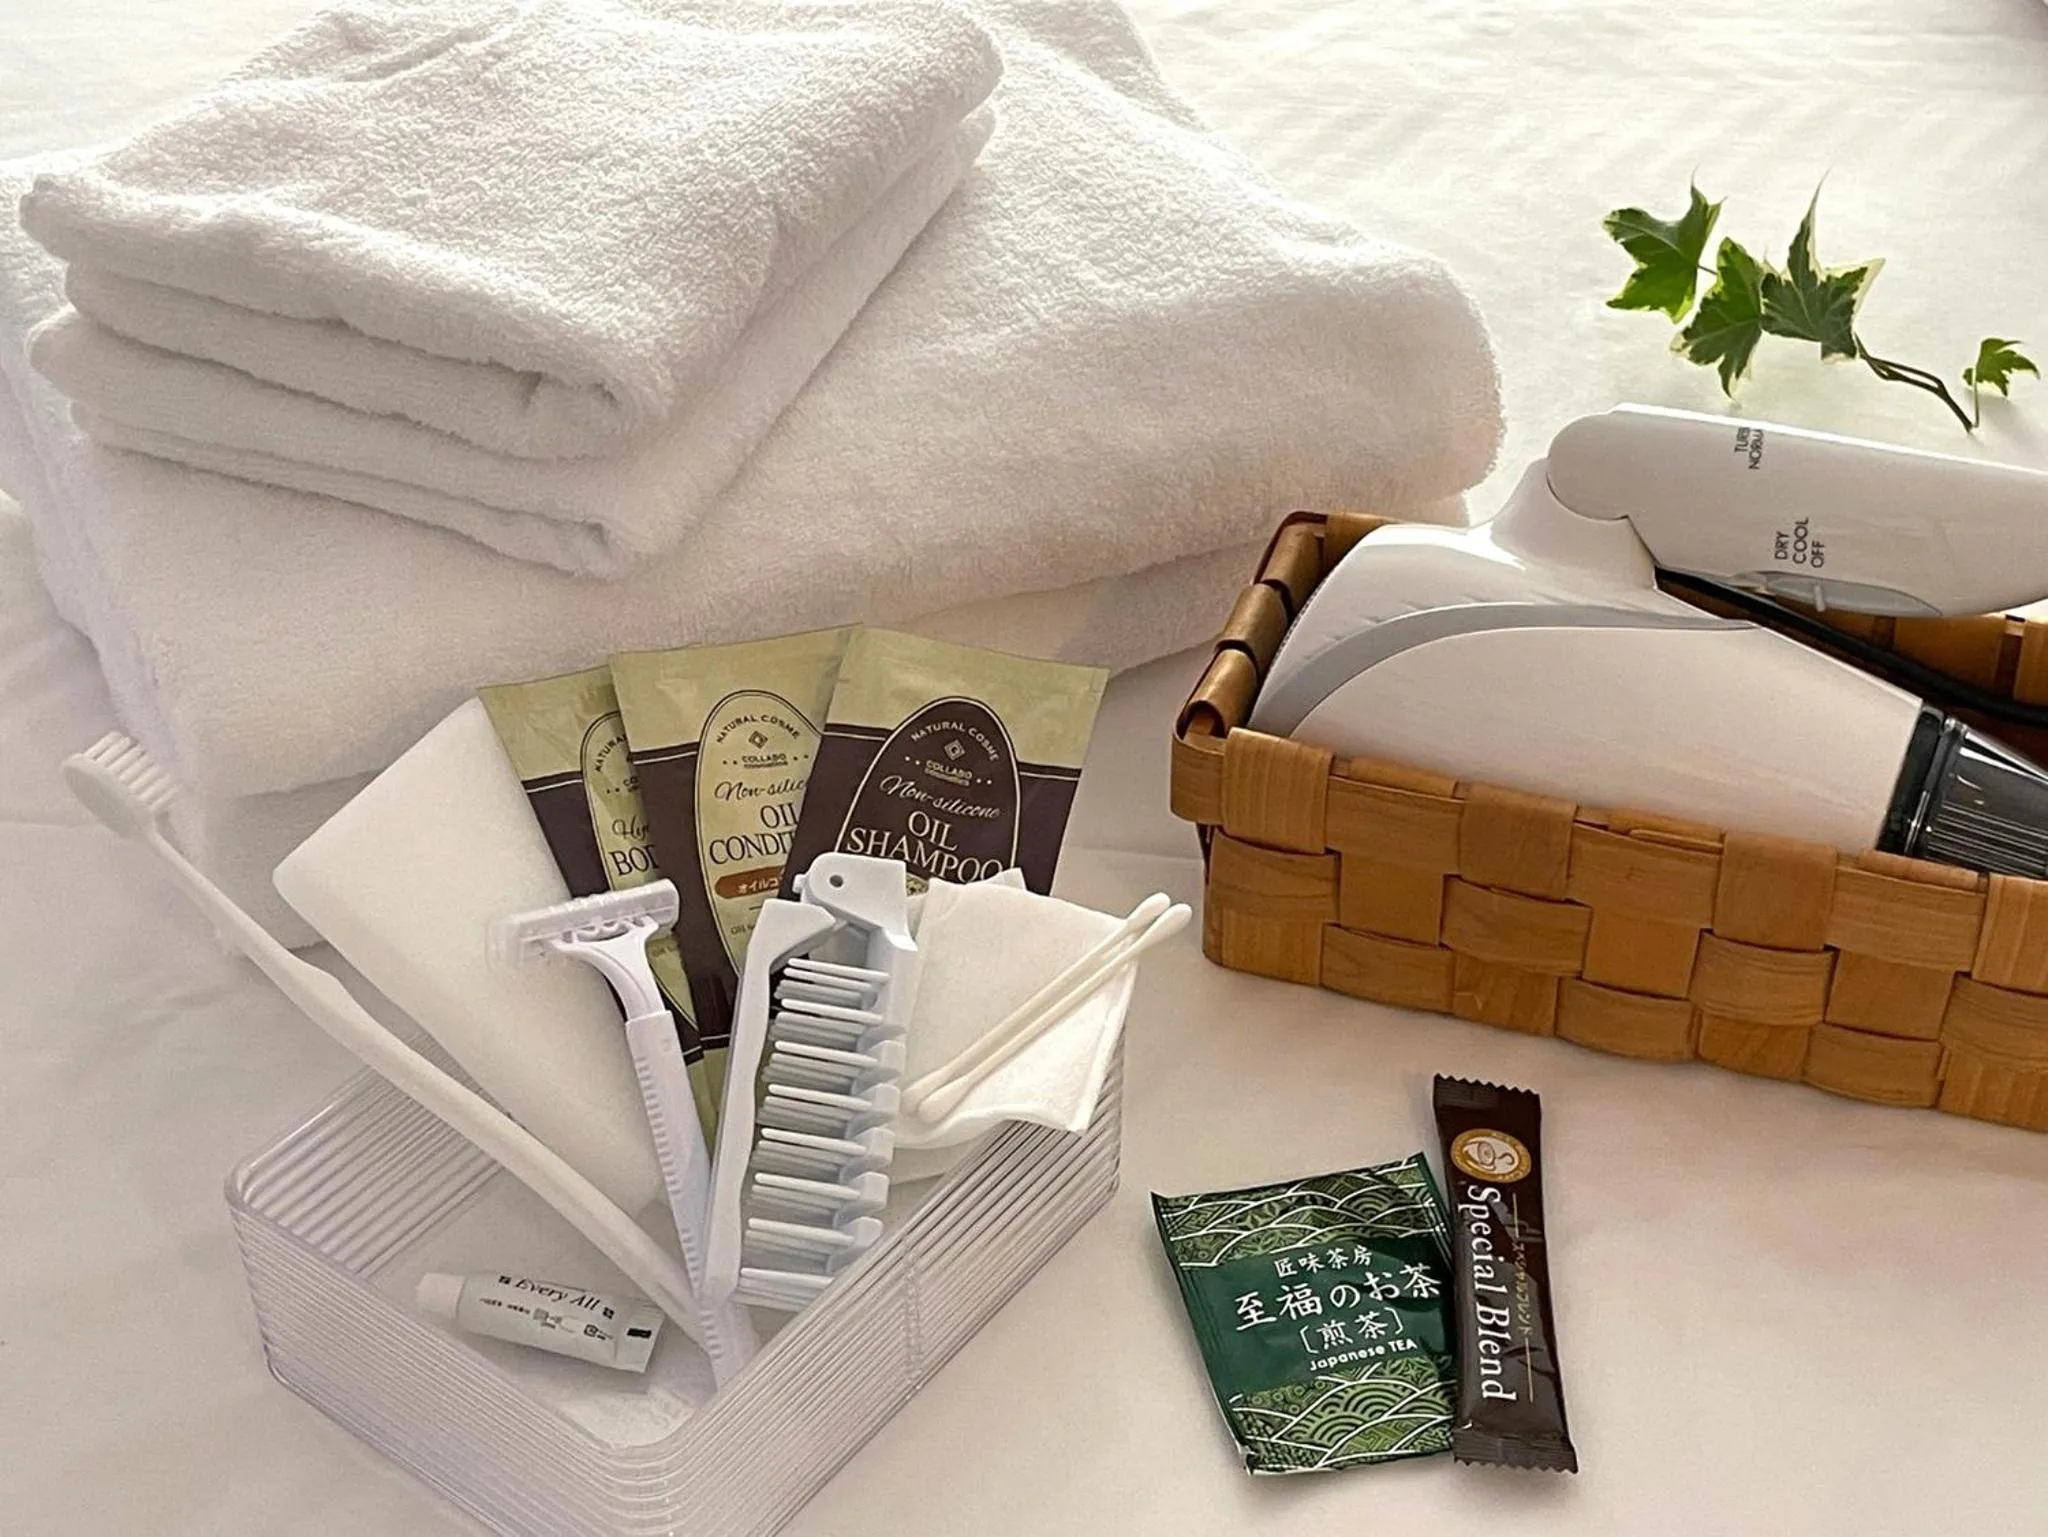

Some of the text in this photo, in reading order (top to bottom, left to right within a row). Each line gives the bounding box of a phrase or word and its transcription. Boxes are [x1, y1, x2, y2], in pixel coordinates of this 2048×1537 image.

[1774, 531, 1789, 560] DRY
[1792, 516, 1809, 564] COOL
[1811, 540, 1826, 568] OFF
[716, 714, 801, 743] NATURAL COSME
[911, 721, 1000, 761] NATURAL COSME
[595, 733, 628, 772] NATURA
[714, 778, 806, 801] Non-silic
[880, 775, 1000, 819] Non-silicone
[908, 810, 958, 851] OIL
[847, 827, 1003, 884] SHAMPOO
[1457, 1184, 1508, 1295] Special
[1273, 1245, 1374, 1278] 匠味茶房
[515, 1278, 600, 1310] Every All
[1235, 1262, 1442, 1331] 至福のお茶
[1309, 1338, 1418, 1371] Japanese TEA
[1475, 1302, 1516, 1401] Blend
